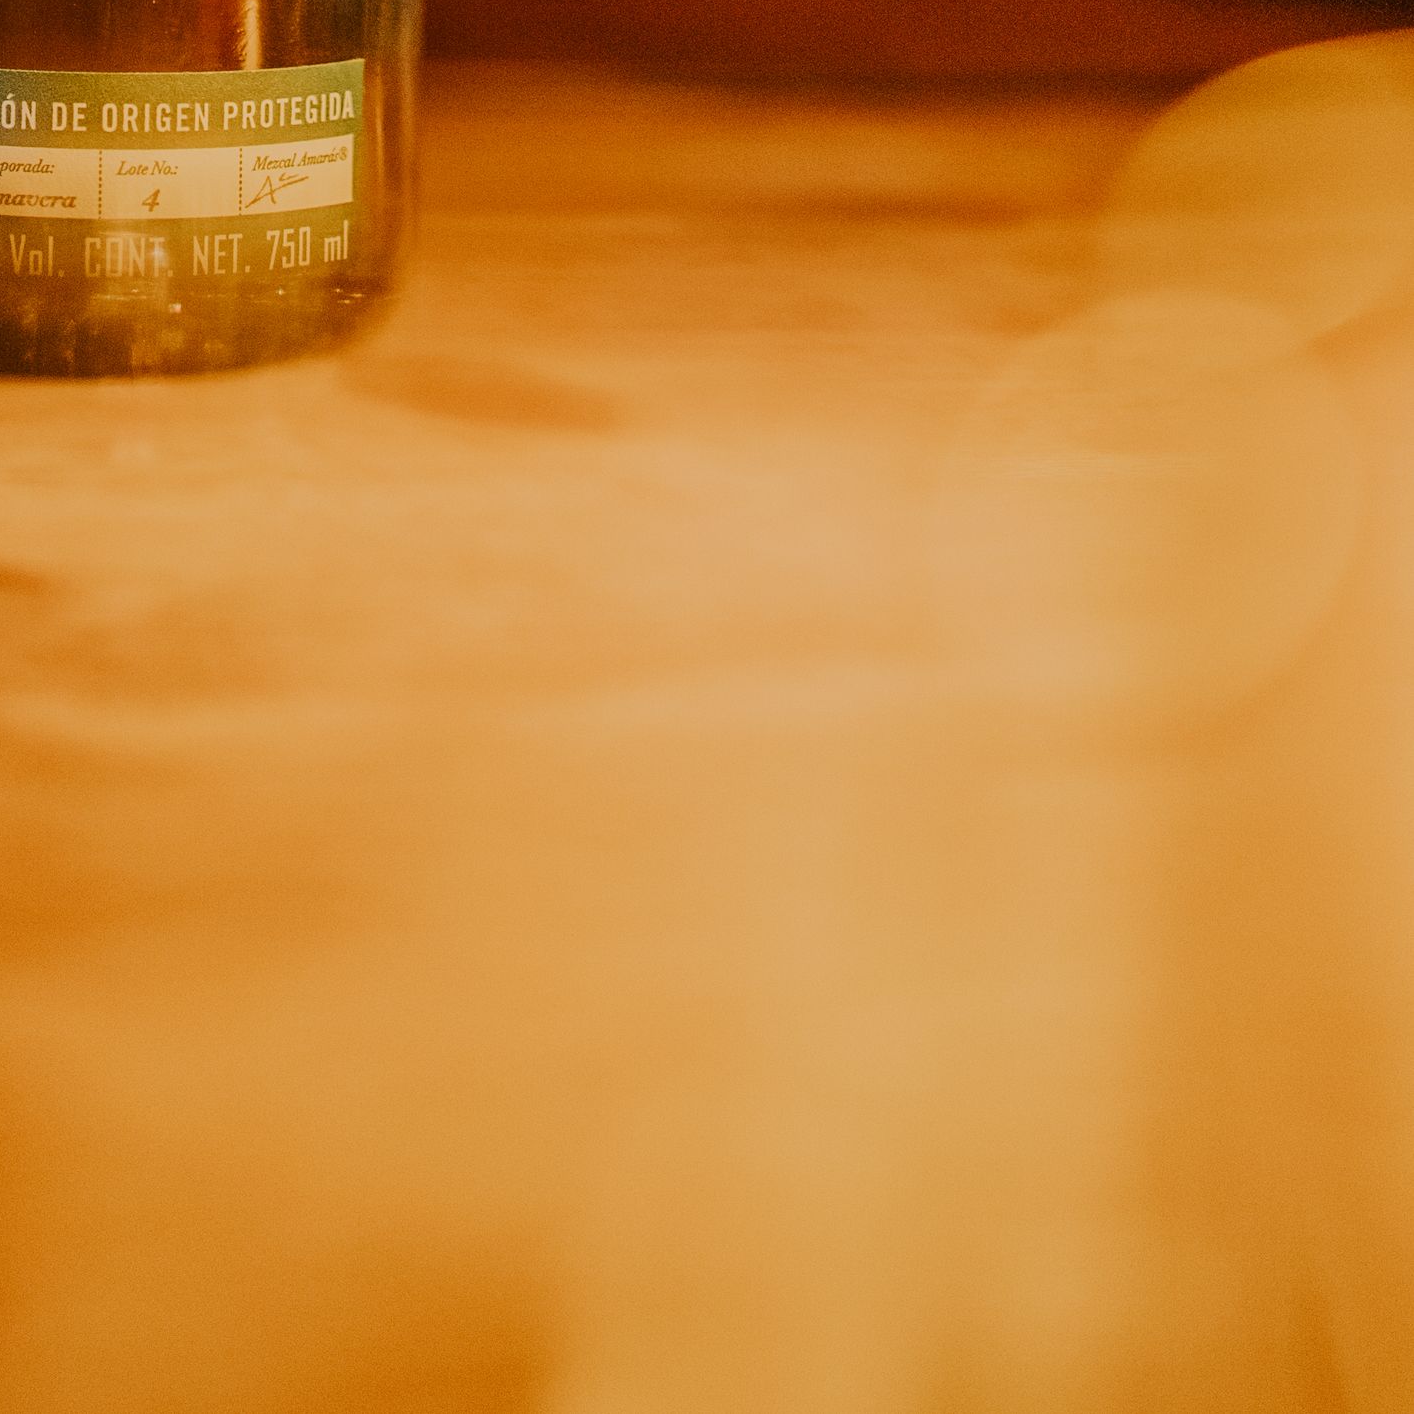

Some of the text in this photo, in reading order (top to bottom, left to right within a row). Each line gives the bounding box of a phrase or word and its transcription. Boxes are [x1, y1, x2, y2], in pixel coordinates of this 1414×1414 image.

[52, 102, 87, 132] DE
[102, 102, 209, 132] ORIGEN
[223, 90, 355, 131] PROTEGIDA
[116, 161, 150, 176] Lote
[252, 152, 296, 171] Mezcal
[141, 188, 160, 212] 4
[9, 233, 65, 278] Vol.
[86, 236, 173, 278] CONT.
[192, 233, 251, 276] NET.
[266, 225, 311, 270] 750
[323, 219, 349, 263] ml
